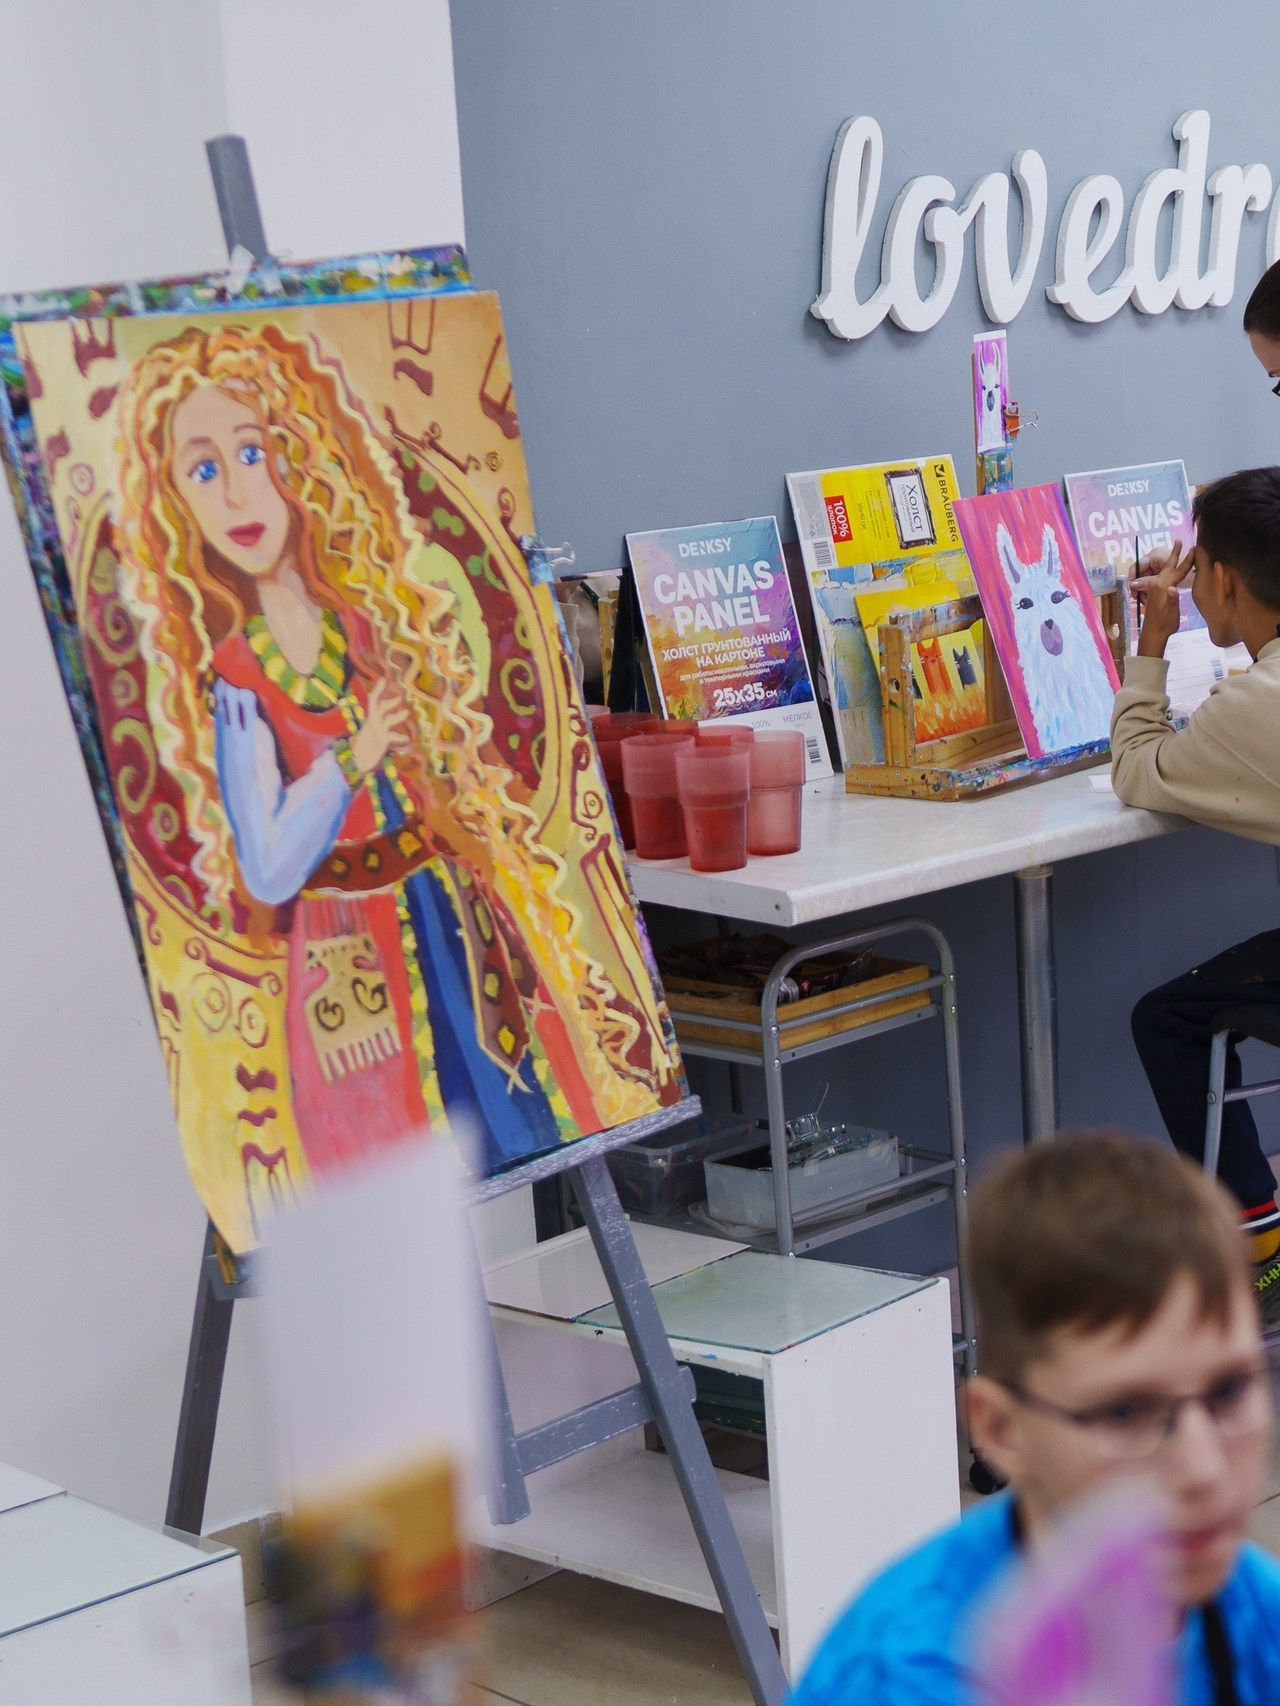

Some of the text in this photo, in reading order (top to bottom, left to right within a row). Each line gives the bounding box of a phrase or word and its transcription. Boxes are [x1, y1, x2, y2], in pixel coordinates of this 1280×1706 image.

[833, 500, 849, 538] 100%
[938, 480, 959, 542] BRAUBERG
[1088, 500, 1184, 538] CANVAS
[653, 560, 775, 604] CANVAS
[673, 595, 770, 635] PANEL
[663, 629, 792, 661] ХОЛСТ ГРУНТОВАННЫЙ
[696, 647, 766, 668] НА КАРТОНЕ
[783, 711, 813, 723] МЕЛКОЕ
